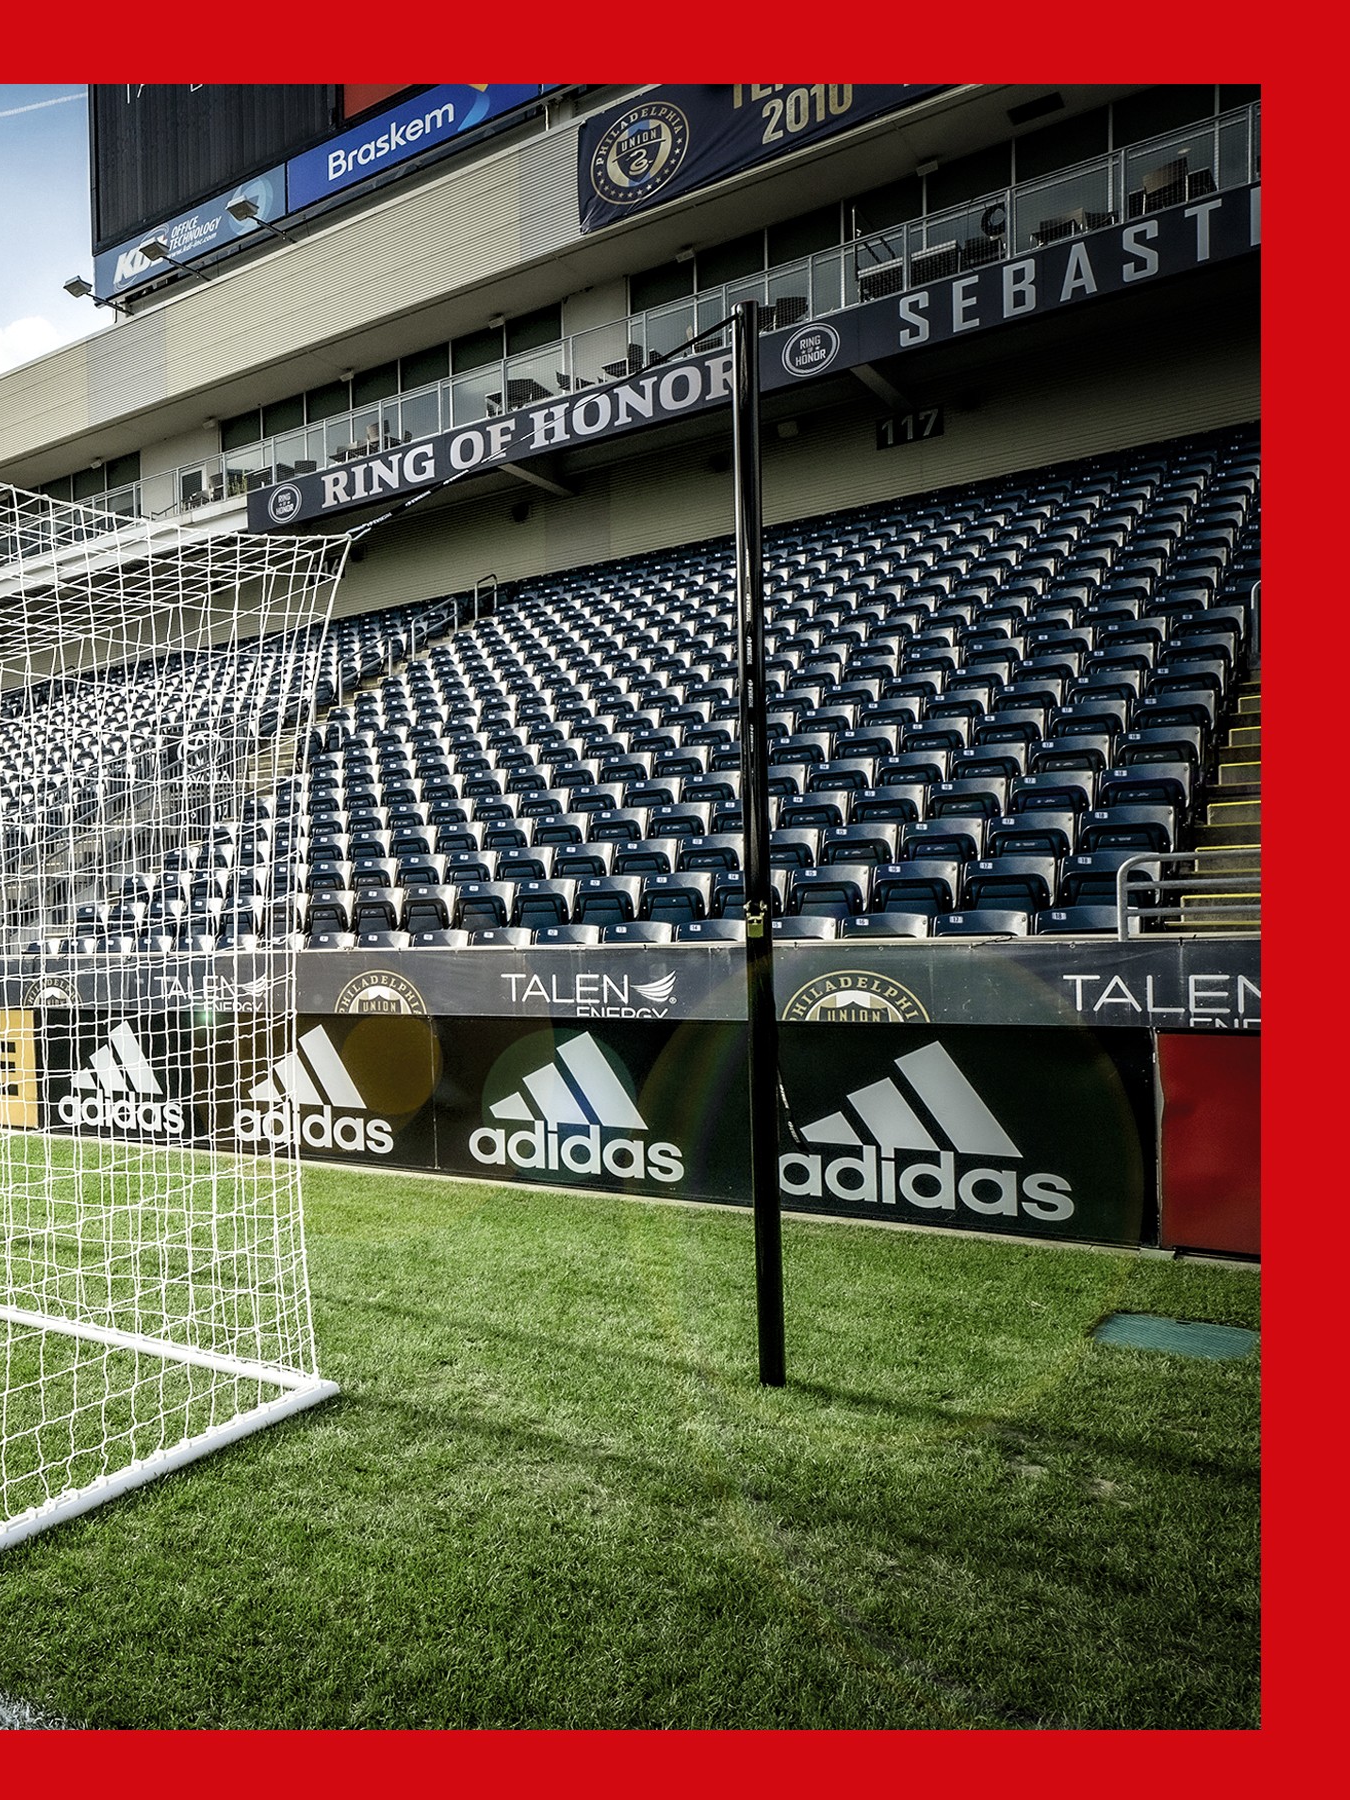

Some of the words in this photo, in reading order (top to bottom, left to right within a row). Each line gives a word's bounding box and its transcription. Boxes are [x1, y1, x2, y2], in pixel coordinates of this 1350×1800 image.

[762, 84, 853, 144] 2010
[328, 102, 454, 181] Braskem
[595, 106, 683, 166] PHILADELPHIA
[620, 129, 658, 152] UNION
[169, 216, 222, 249] TECHNOLOGY
[171, 215, 199, 239] OFFICE
[795, 348, 826, 367] HONOR
[800, 335, 821, 350] RING
[321, 443, 435, 508] RING
[450, 418, 519, 470] OF
[529, 353, 734, 450] HONOR
[881, 408, 939, 446] 117
[154, 976, 238, 1000] TALEN
[363, 1001, 396, 1012] UNION
[501, 974, 629, 1004] TALEN
[1063, 975, 1261, 1014] TALEN
[58, 1089, 185, 1134] adidas
[232, 1102, 394, 1154] adidas
[469, 1120, 685, 1182] adidas
[779, 1144, 1075, 1222] adidas
